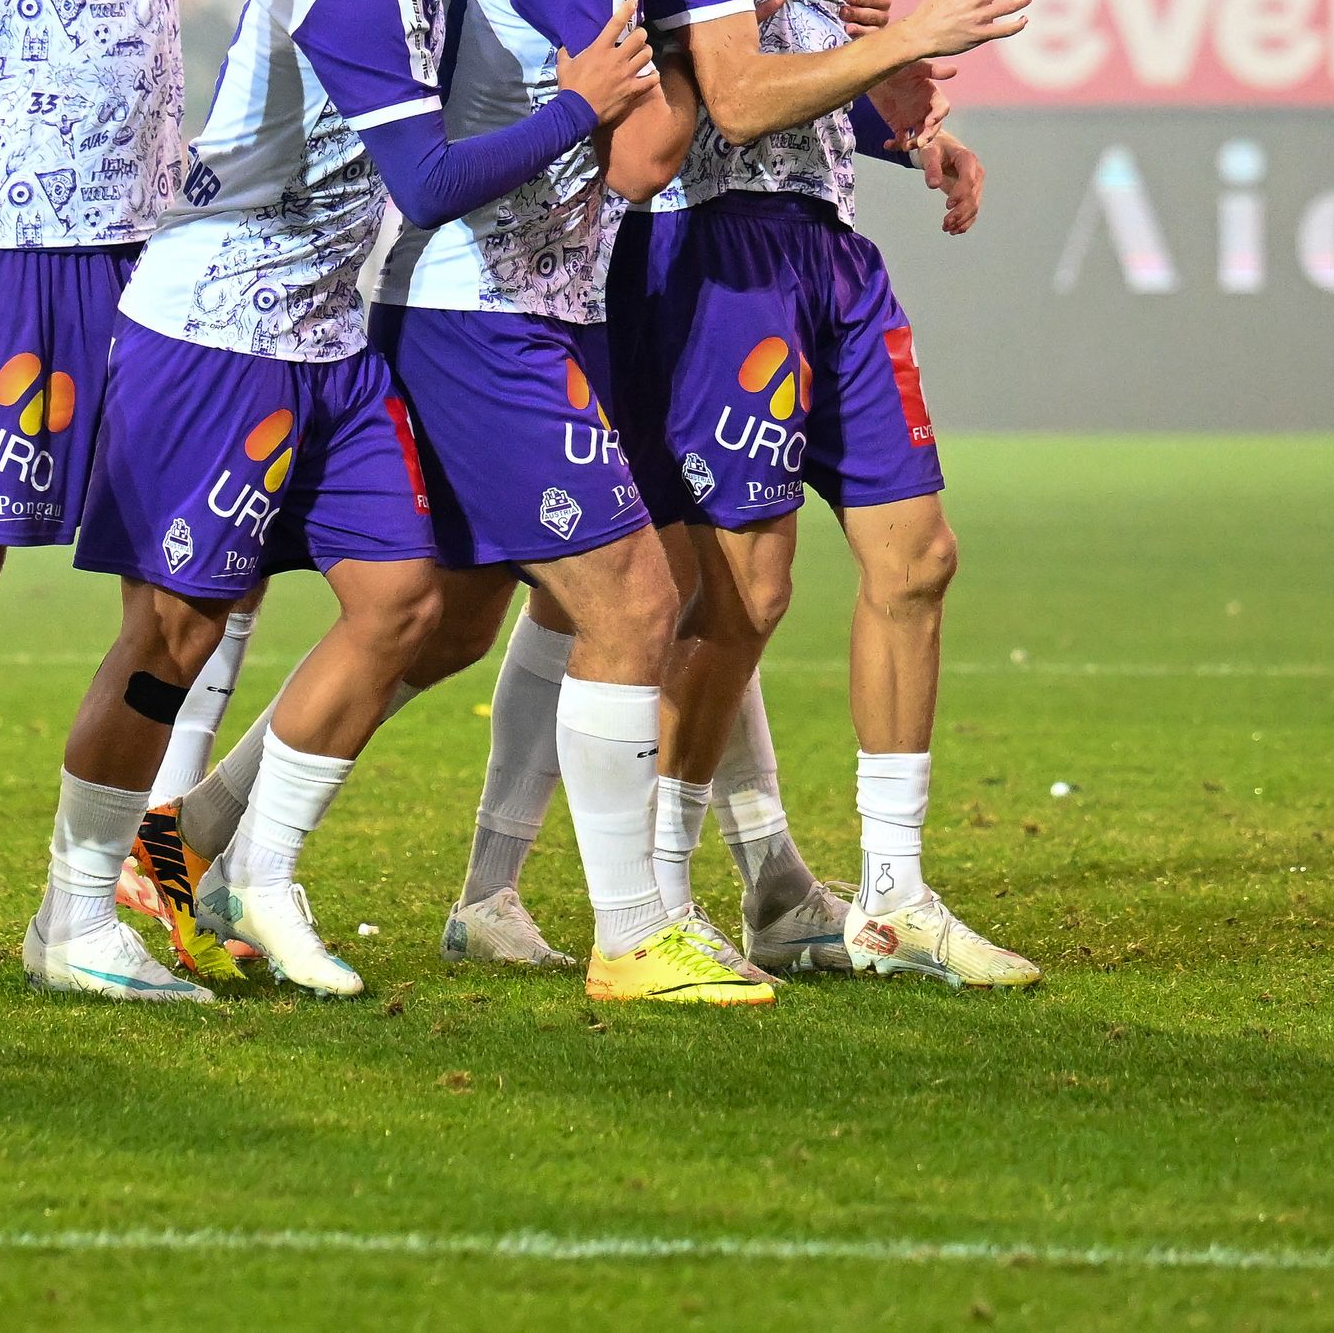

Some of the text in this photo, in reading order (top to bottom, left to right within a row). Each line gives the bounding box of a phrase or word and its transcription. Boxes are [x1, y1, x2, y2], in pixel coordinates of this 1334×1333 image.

[27, 92, 61, 115] 33
[564, 422, 629, 466] UR
[714, 405, 807, 474] URO
[746, 479, 802, 505] Ponga
[544, 507, 577, 520] AUSTRIA
[138, 812, 196, 918] NIKE
